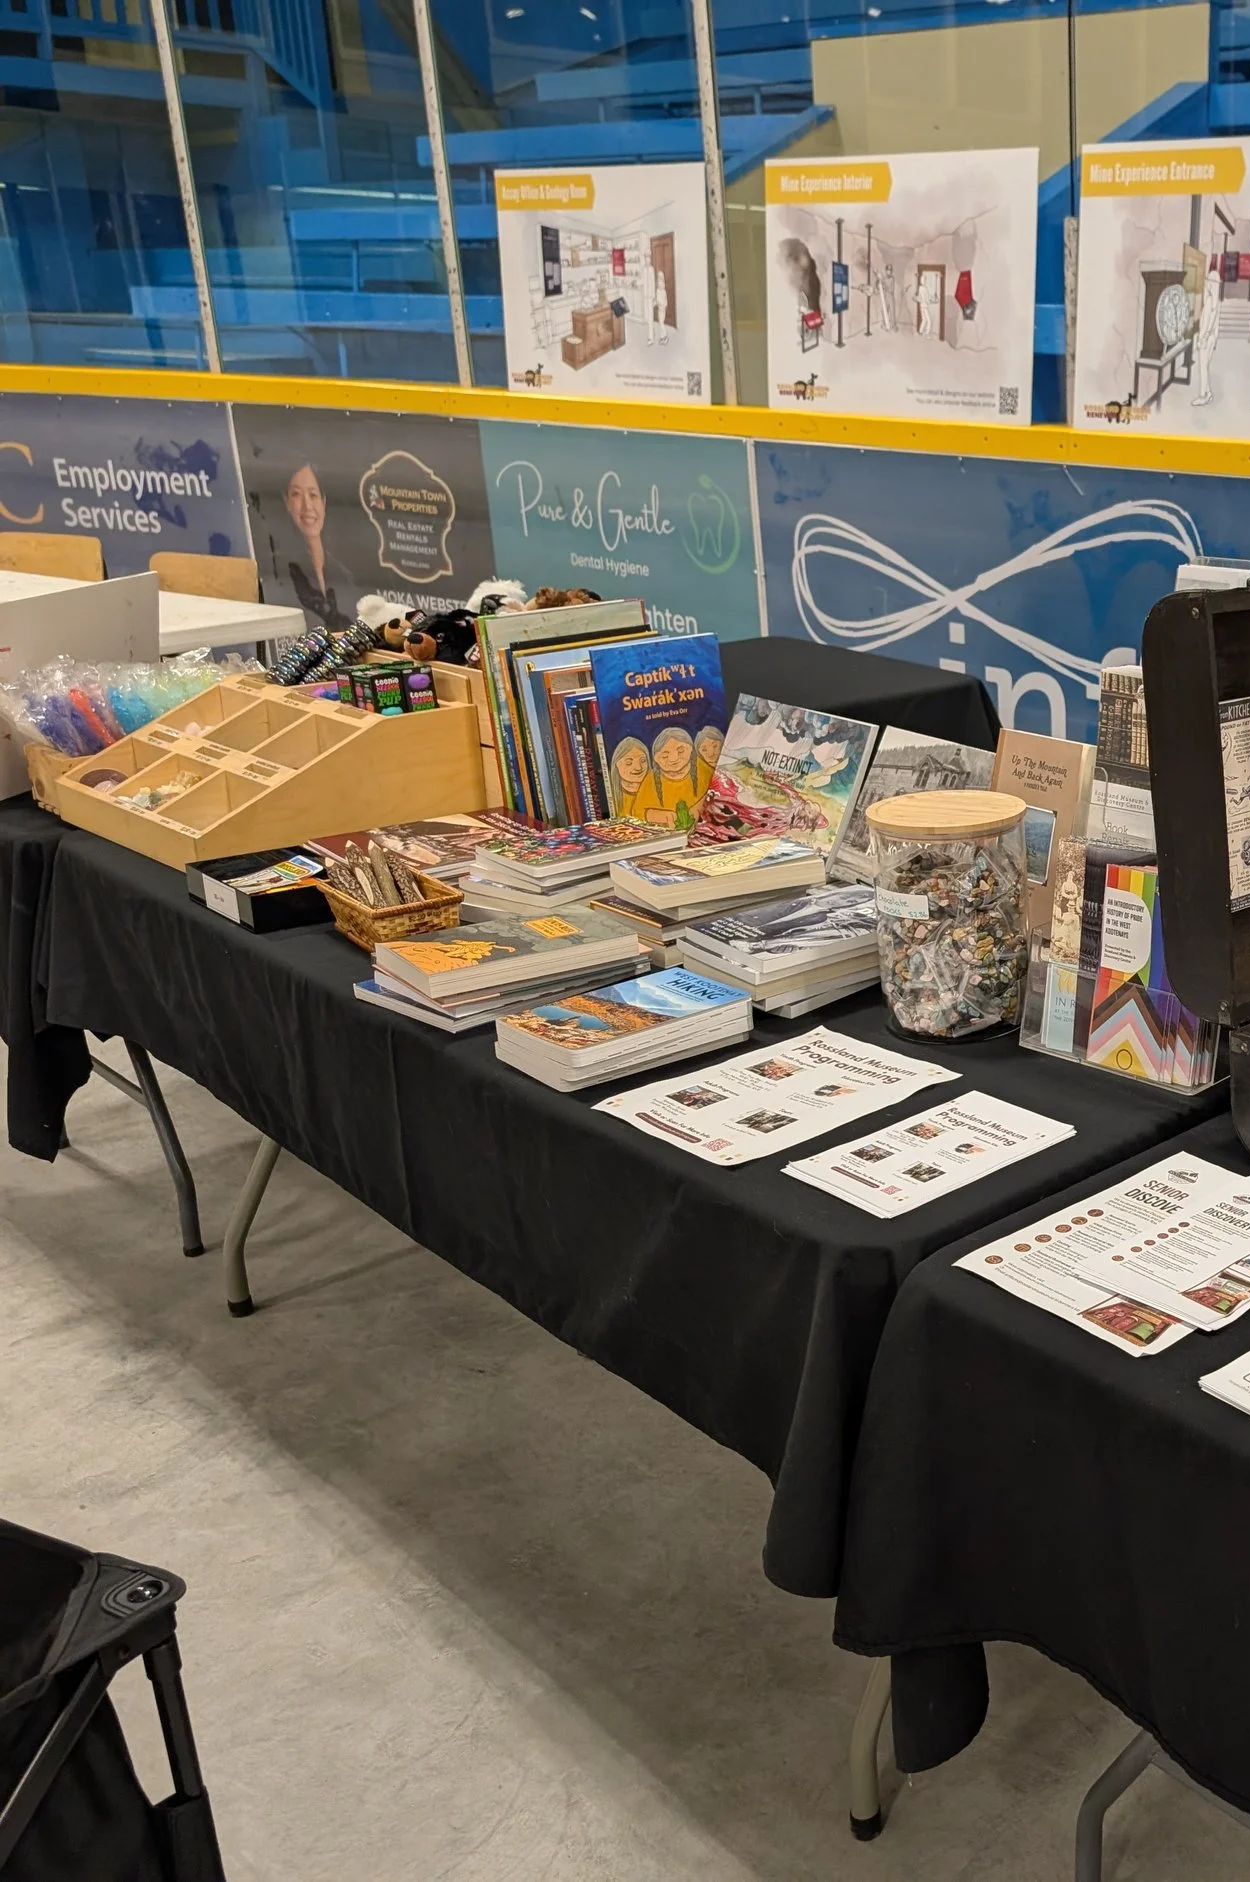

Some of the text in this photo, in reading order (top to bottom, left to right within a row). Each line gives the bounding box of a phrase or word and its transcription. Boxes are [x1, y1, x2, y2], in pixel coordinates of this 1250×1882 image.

[1090, 162, 1215, 186] Mine Experience Entrance
[53, 458, 212, 500] Employment
[61, 498, 161, 533] Services
[496, 461, 675, 551] Pure & Gentle
[571, 553, 649, 577] Dental Hygiene
[762, 749, 813, 775] NOT EXTINCT
[1012, 755, 1067, 777] Up The Mountain
[1012, 768, 1026, 779] And
[1027, 771, 1044, 784] Back
[1045, 775, 1062, 789] Again
[1106, 822, 1128, 833] Book
[1107, 908, 1123, 918] HISTORY
[1131, 914, 1142, 922] PRIDE
[666, 978, 724, 999] HIKING
[674, 972, 697, 981] WEST
[786, 1044, 903, 1087] Programming
[806, 1039, 919, 1078] Rossland Museum
[931, 1110, 1020, 1147] Programming
[945, 1106, 1030, 1140] Rossland Museum
[1142, 1179, 1190, 1202] SENIOR
[1214, 1201, 1250, 1217] SENIOR
